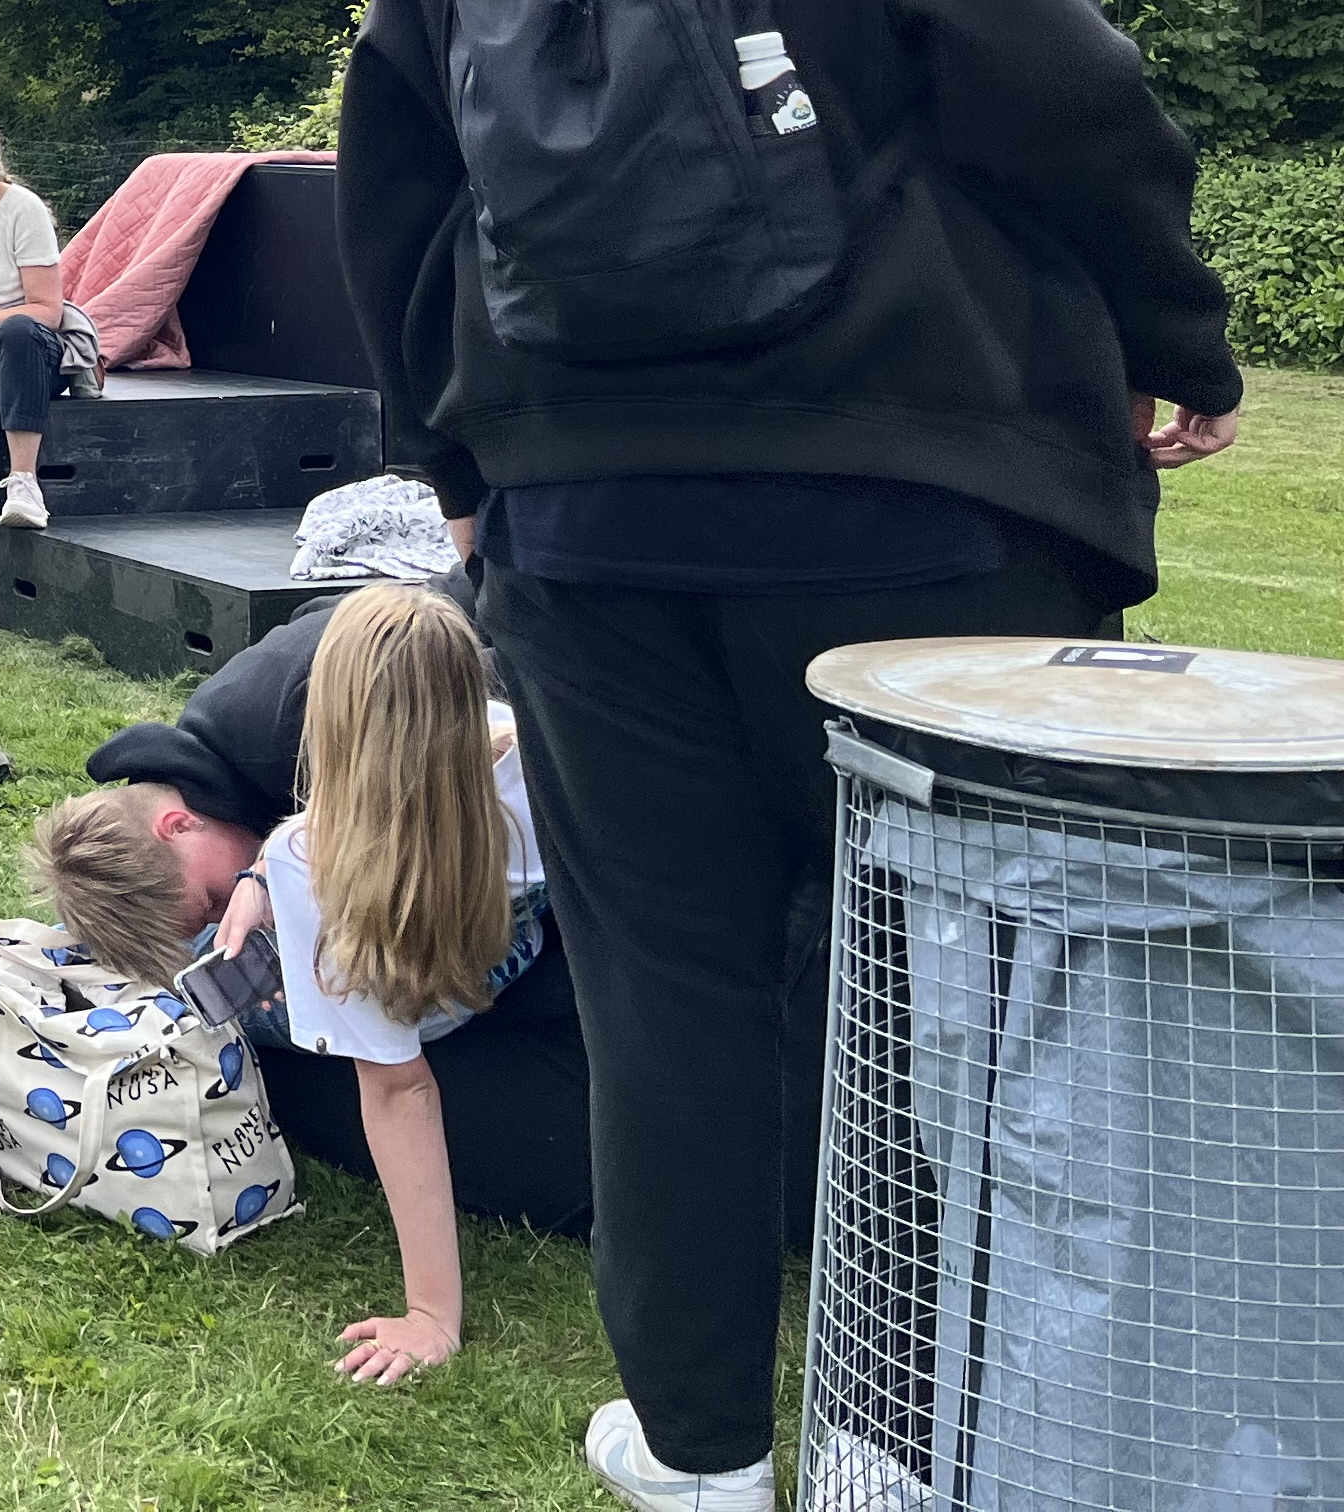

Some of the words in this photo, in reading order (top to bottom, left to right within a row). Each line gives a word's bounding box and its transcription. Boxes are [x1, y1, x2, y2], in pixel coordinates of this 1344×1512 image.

[107, 1069, 179, 1110] NUSA
[211, 1101, 260, 1157] PLANE
[220, 1125, 264, 1175] NUS
